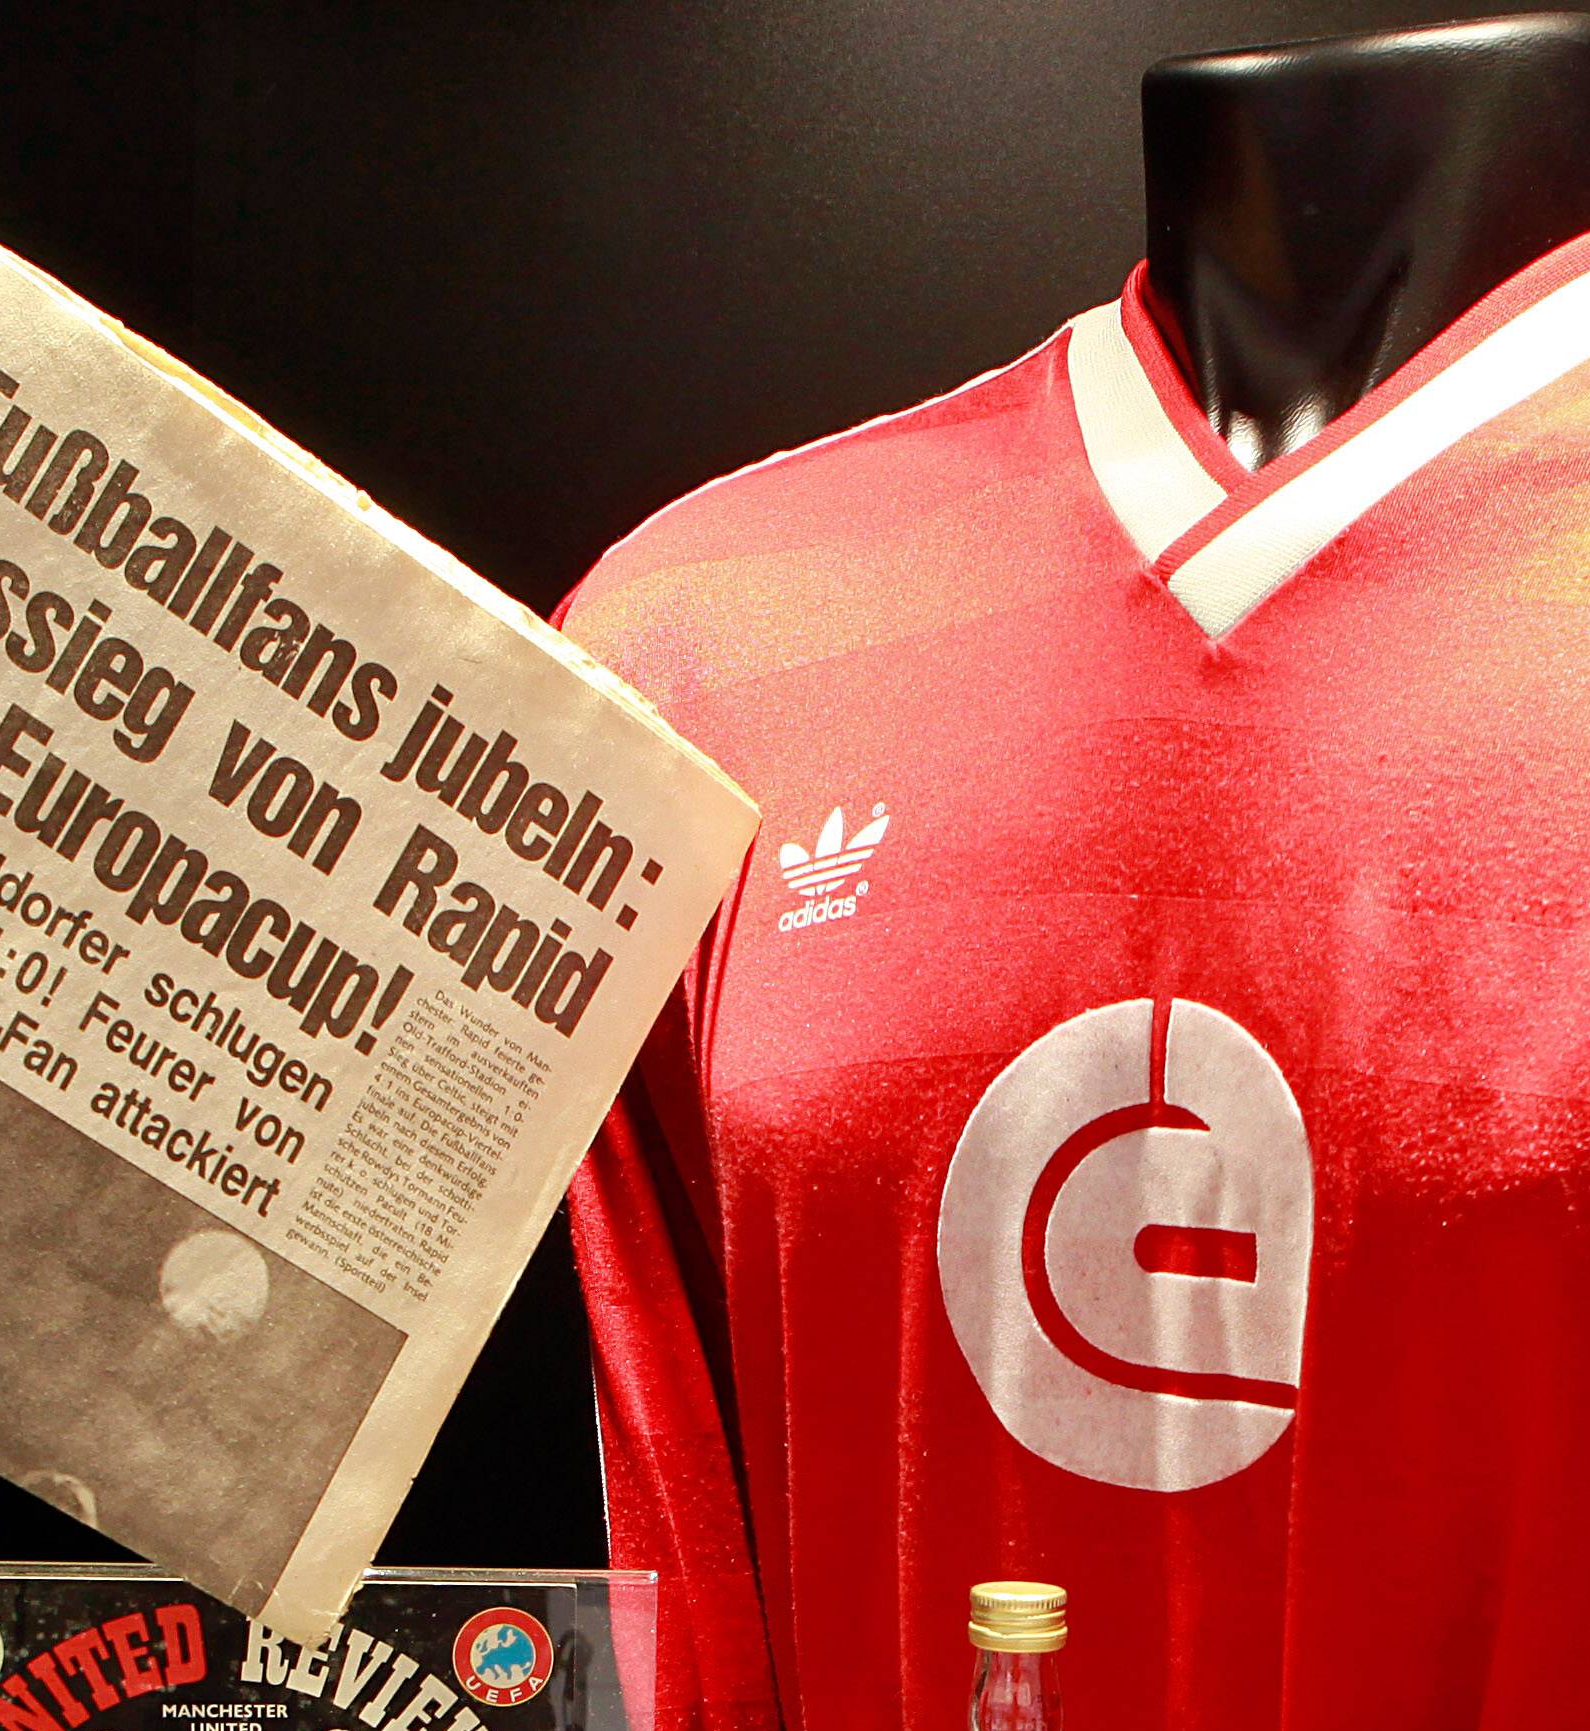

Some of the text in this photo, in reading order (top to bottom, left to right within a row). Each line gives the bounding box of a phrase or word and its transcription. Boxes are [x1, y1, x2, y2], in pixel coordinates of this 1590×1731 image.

[379, 682, 663, 931] jubeln:
[207, 718, 362, 875] von
[372, 822, 613, 1038] Rapid
[777, 895, 857, 932] adidas
[77, 989, 216, 1101] Feurer
[234, 1095, 305, 1163] von
[143, 971, 333, 1112] schlugen
[89, 1081, 280, 1218] attackiert
[161, 1703, 289, 1719] MANCHESTER
[464, 1673, 544, 1704] UEFA
